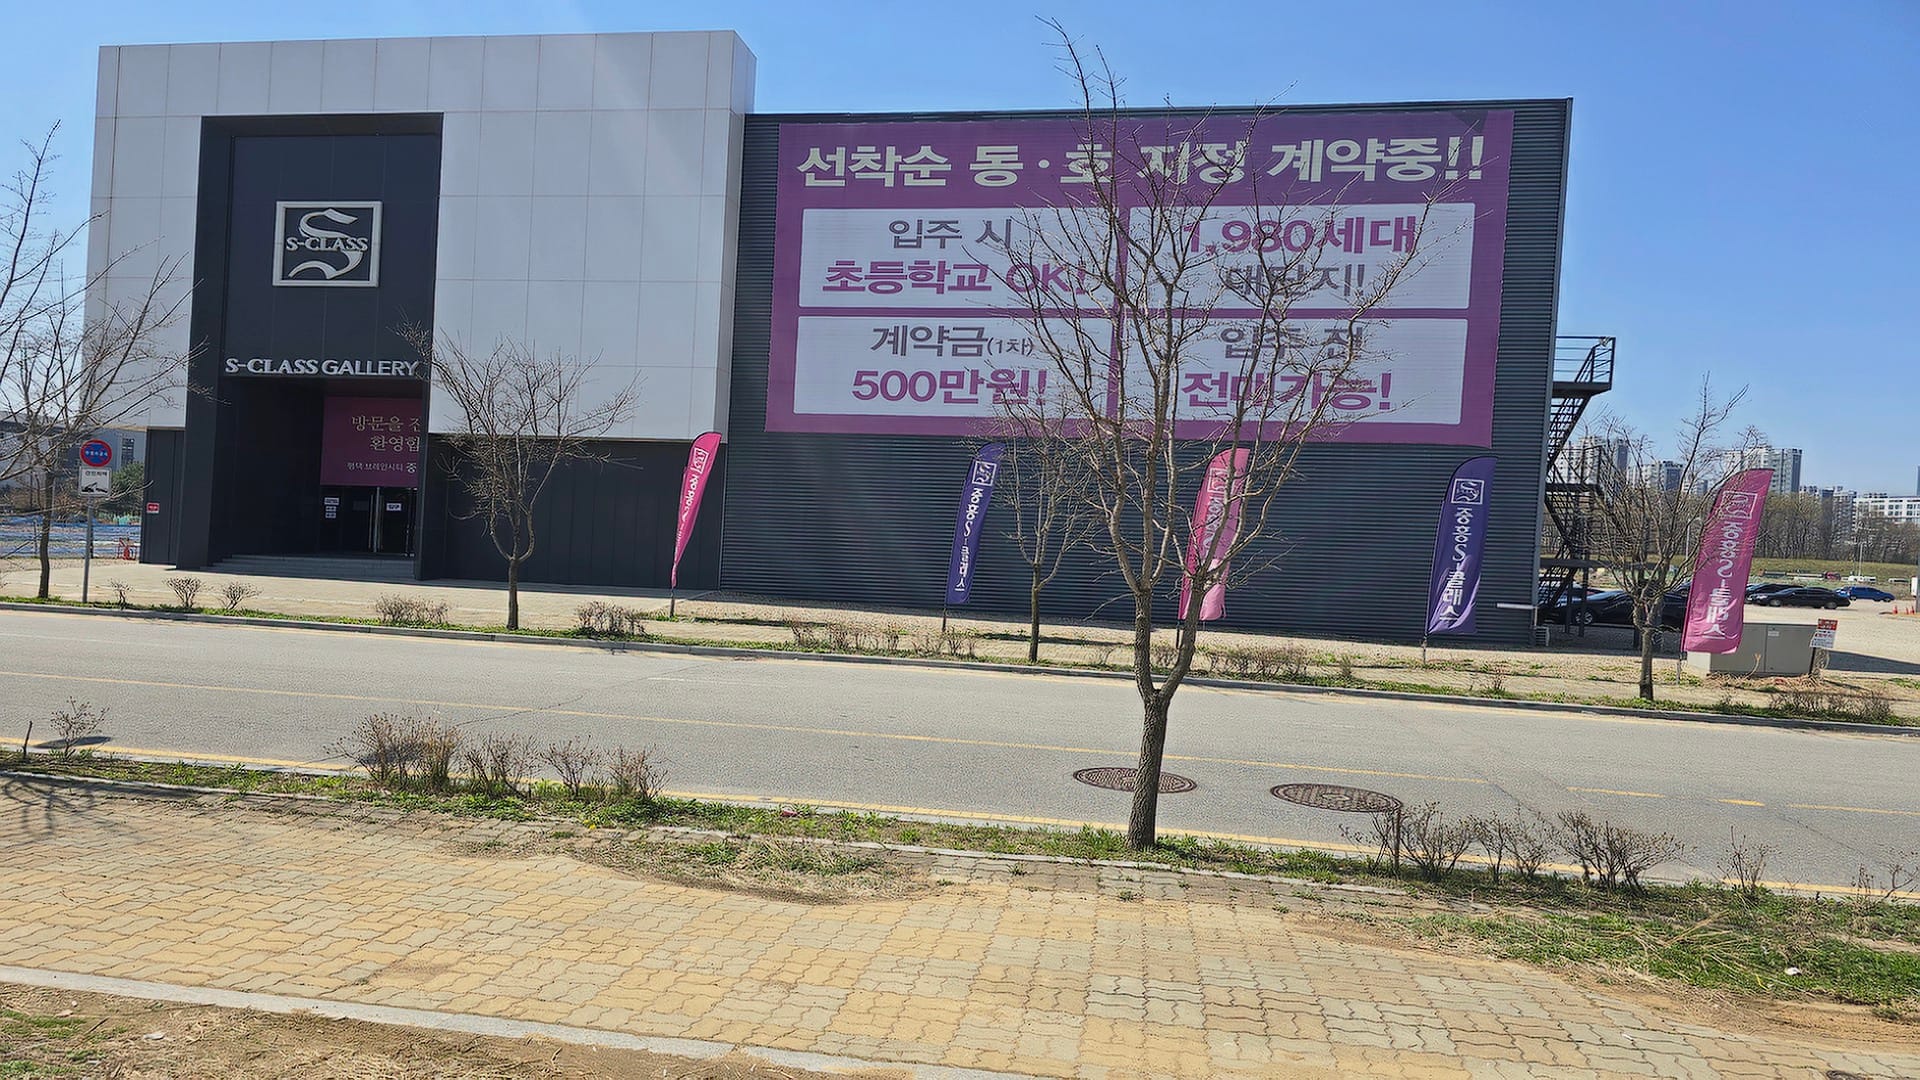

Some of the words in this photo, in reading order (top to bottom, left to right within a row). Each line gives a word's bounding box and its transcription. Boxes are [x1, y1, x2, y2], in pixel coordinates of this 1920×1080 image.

[797, 144, 951, 187] 선착순
[1136, 141, 1246, 185] 지정
[1267, 135, 1484, 183] 계약중!!
[286, 237, 368, 251] S-CLASS
[888, 218, 963, 249] 입주
[975, 218, 1013, 249] 시
[1182, 215, 1417, 254] 1,980세대
[822, 260, 993, 296] 초등학교
[871, 324, 1034, 357] 계약금(1차)
[225, 358, 319, 374] S-CLASS
[321, 359, 420, 377] GALLERY
[852, 368, 1047, 406] 500만원!
[352, 415, 404, 432] 방문을
